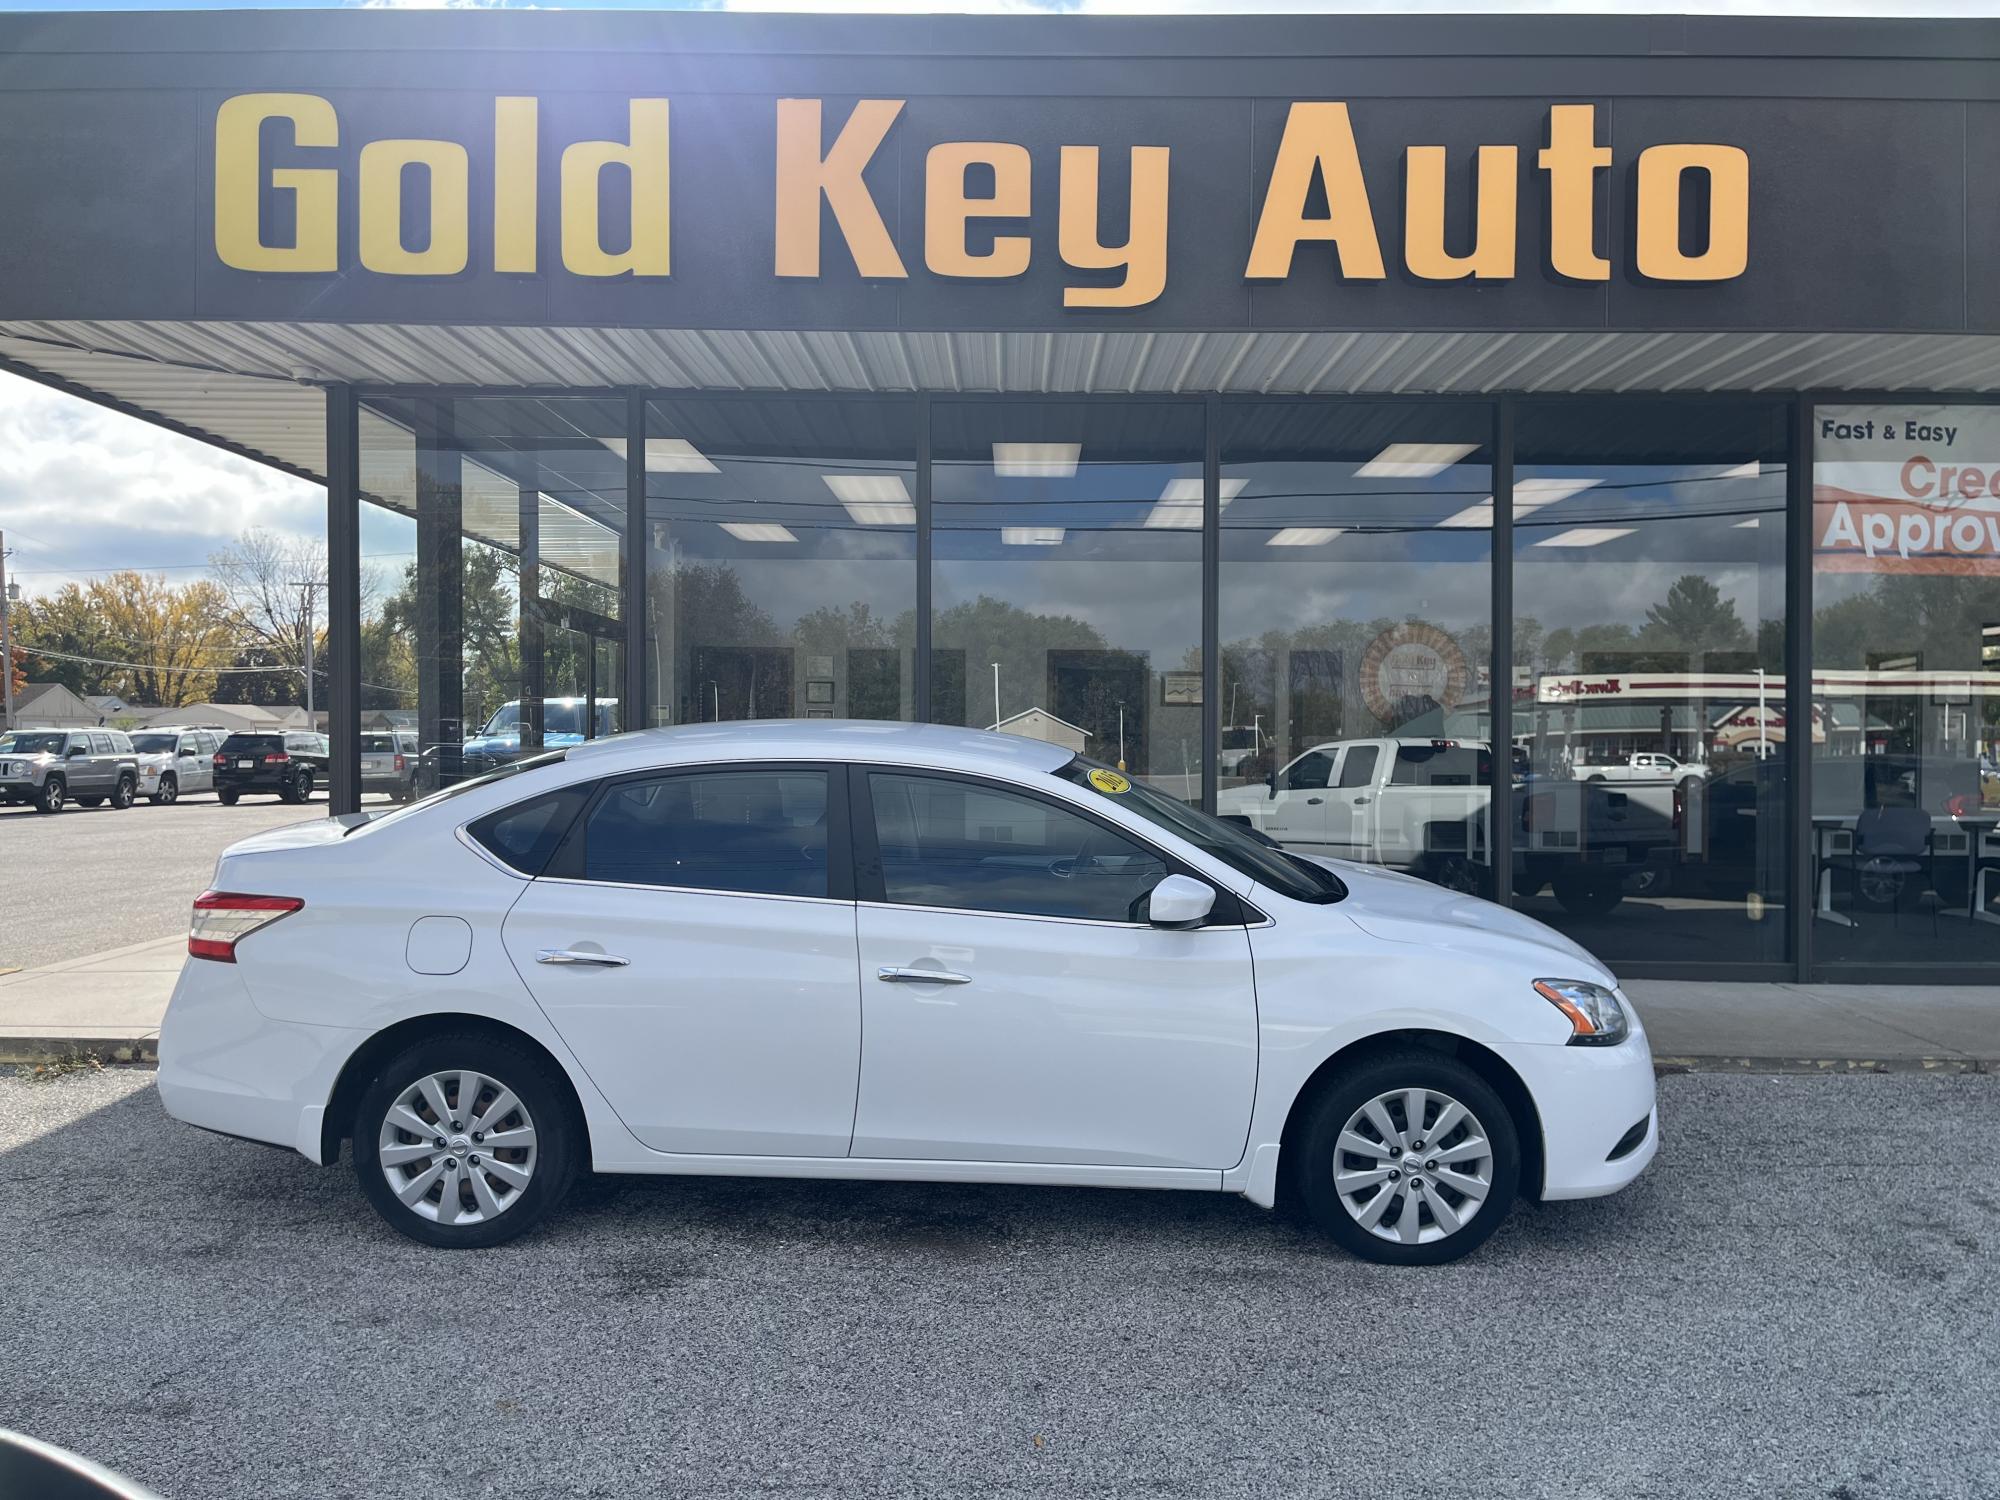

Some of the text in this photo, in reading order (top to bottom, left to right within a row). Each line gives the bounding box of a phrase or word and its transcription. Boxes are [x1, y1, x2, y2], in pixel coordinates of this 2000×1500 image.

[214, 93, 1750, 308] Gold Key Auto
[1822, 420, 1957, 446] Fast & Easy
